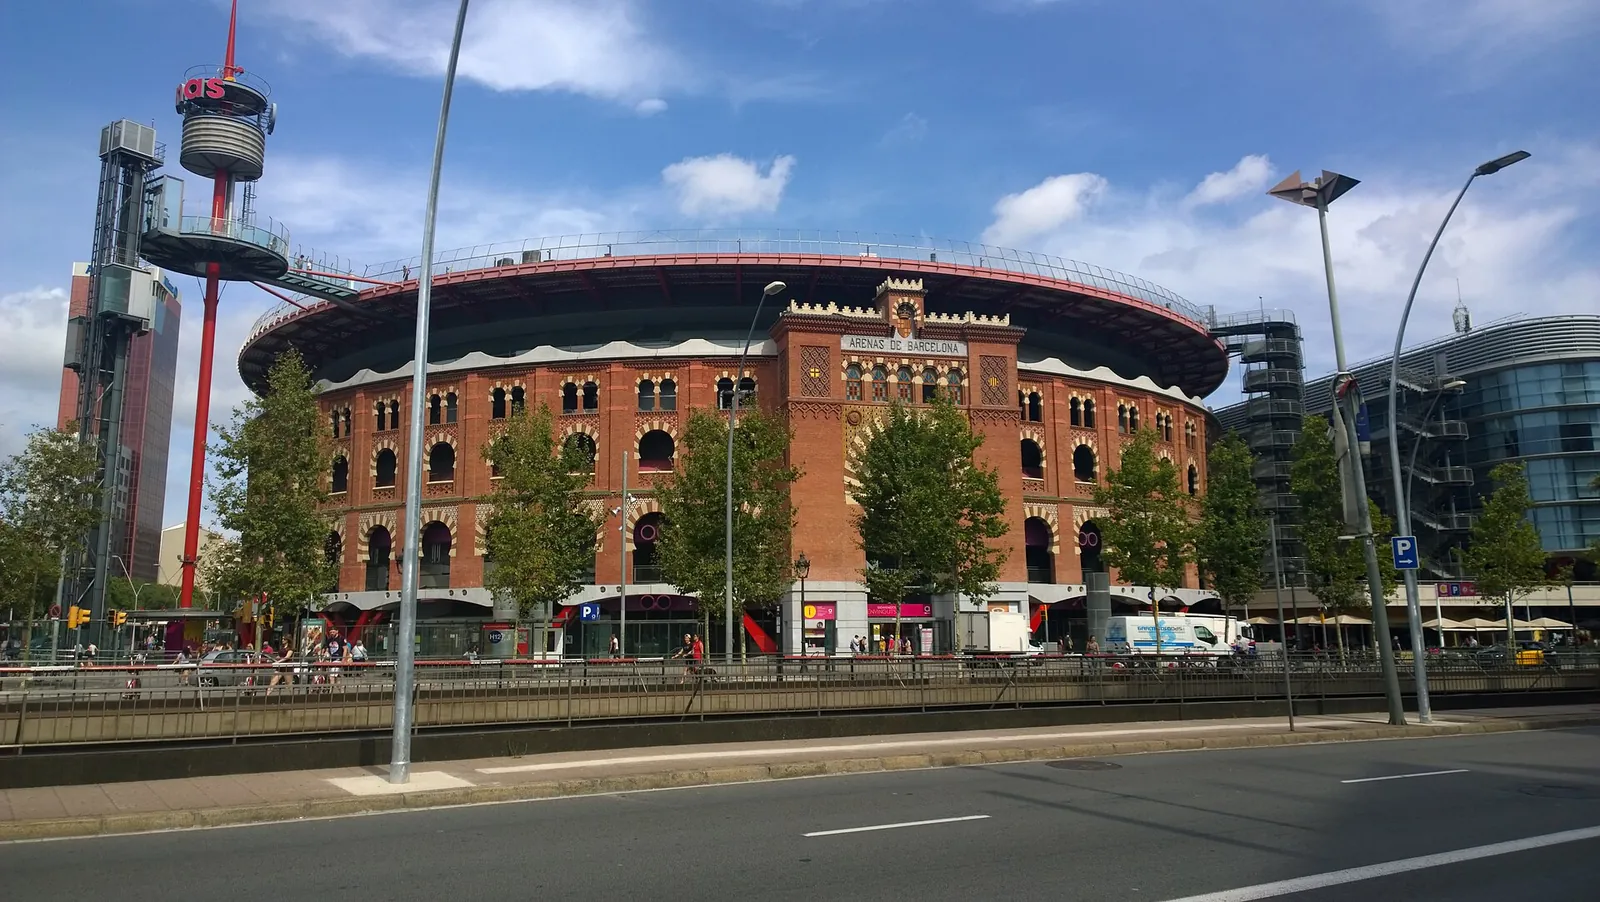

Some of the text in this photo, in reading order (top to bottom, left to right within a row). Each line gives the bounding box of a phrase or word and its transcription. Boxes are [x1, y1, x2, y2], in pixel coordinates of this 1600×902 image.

[849, 337, 959, 354] ARENAS DE BARCELONA
[1396, 539, 1411, 556] P
[583, 606, 592, 618] P
